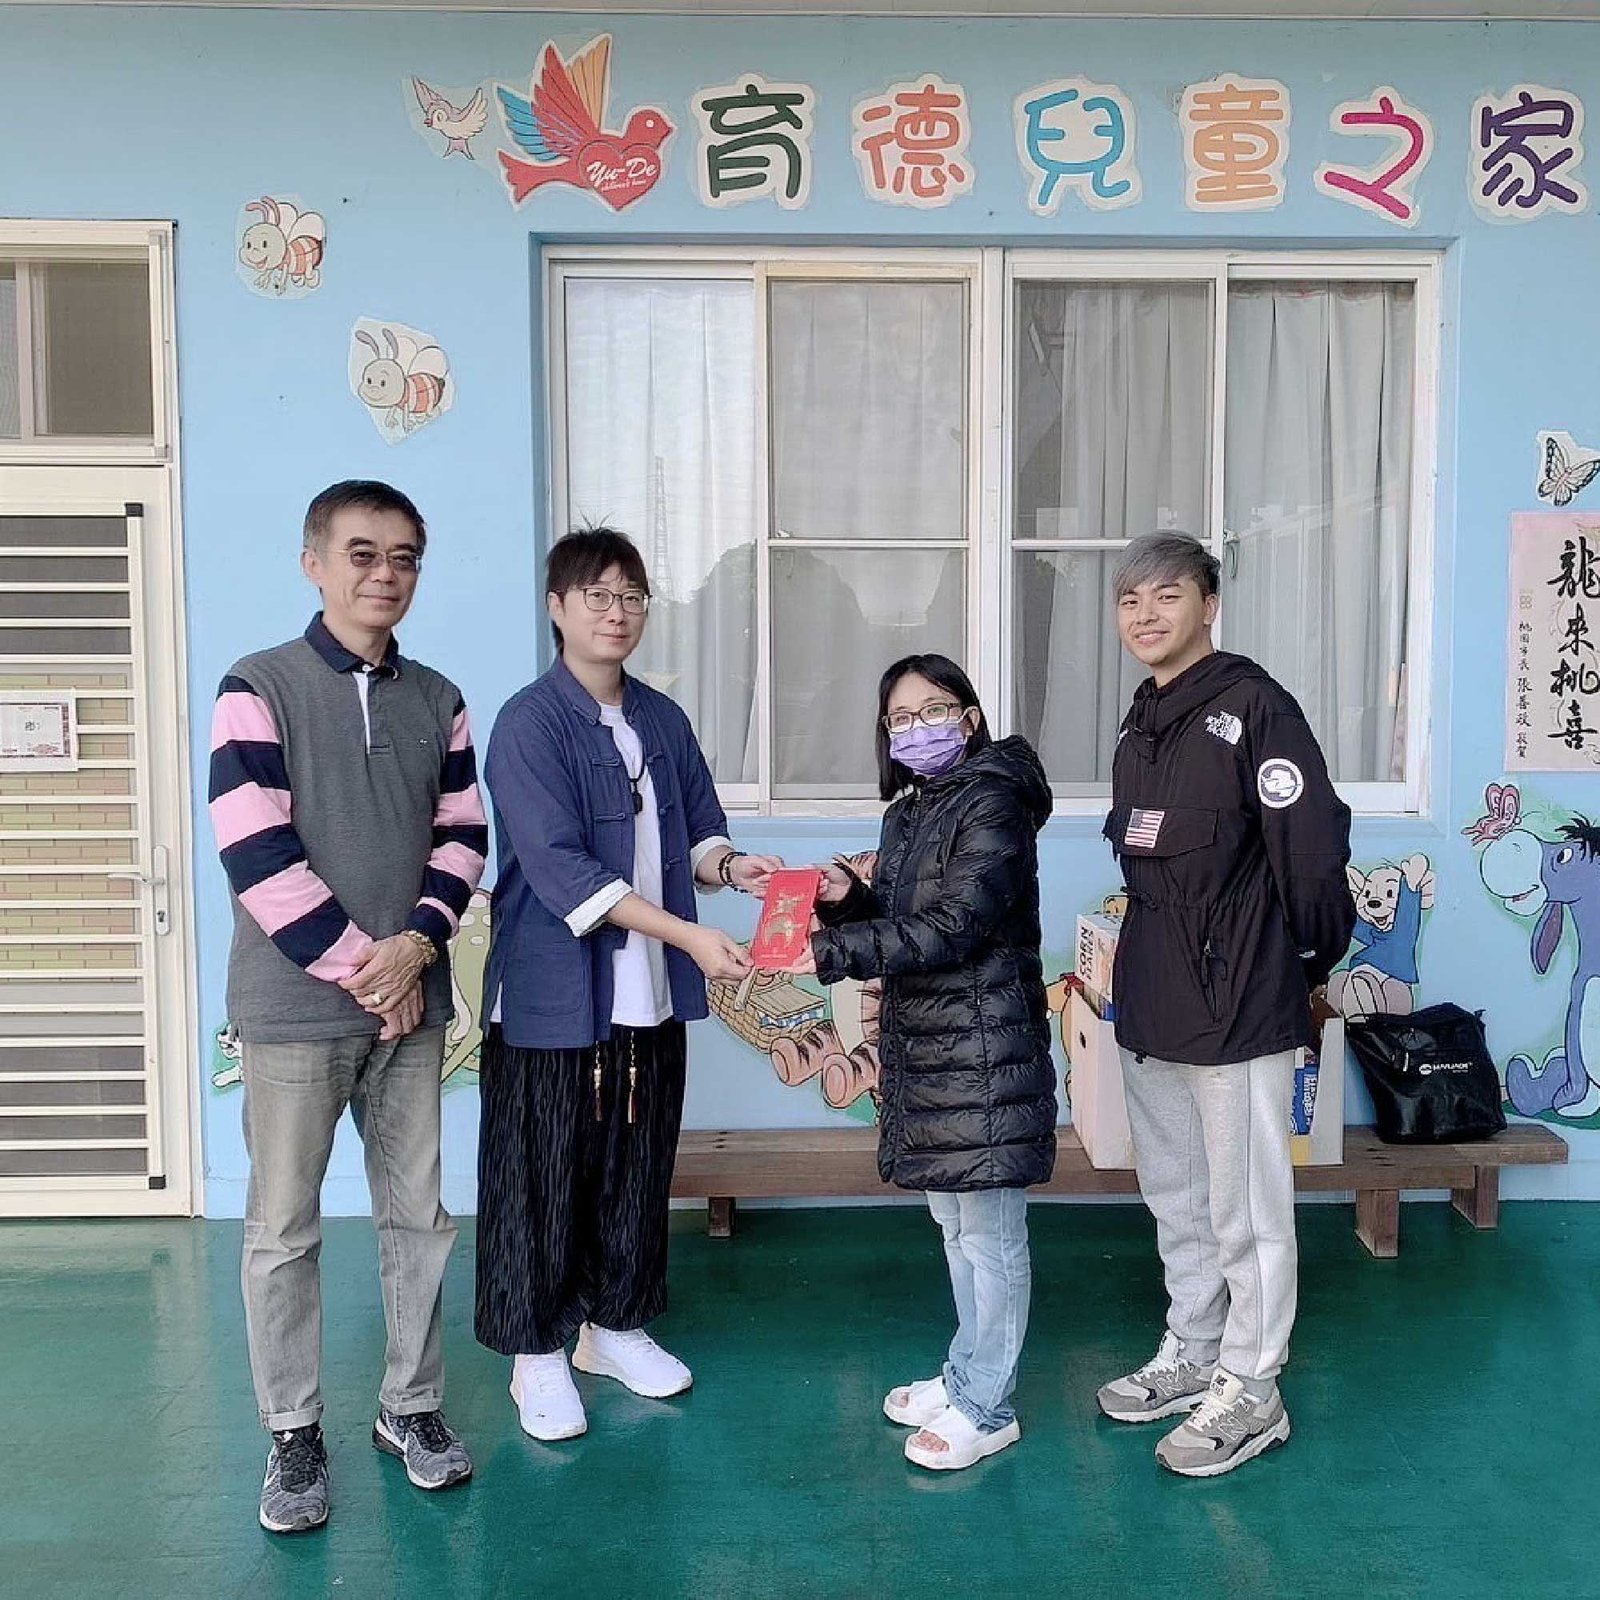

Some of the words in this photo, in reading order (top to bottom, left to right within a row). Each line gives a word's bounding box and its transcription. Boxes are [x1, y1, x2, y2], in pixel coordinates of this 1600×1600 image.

[586, 157, 657, 188] Yu-De
[702, 83, 1579, 220] 育德兒童之家
